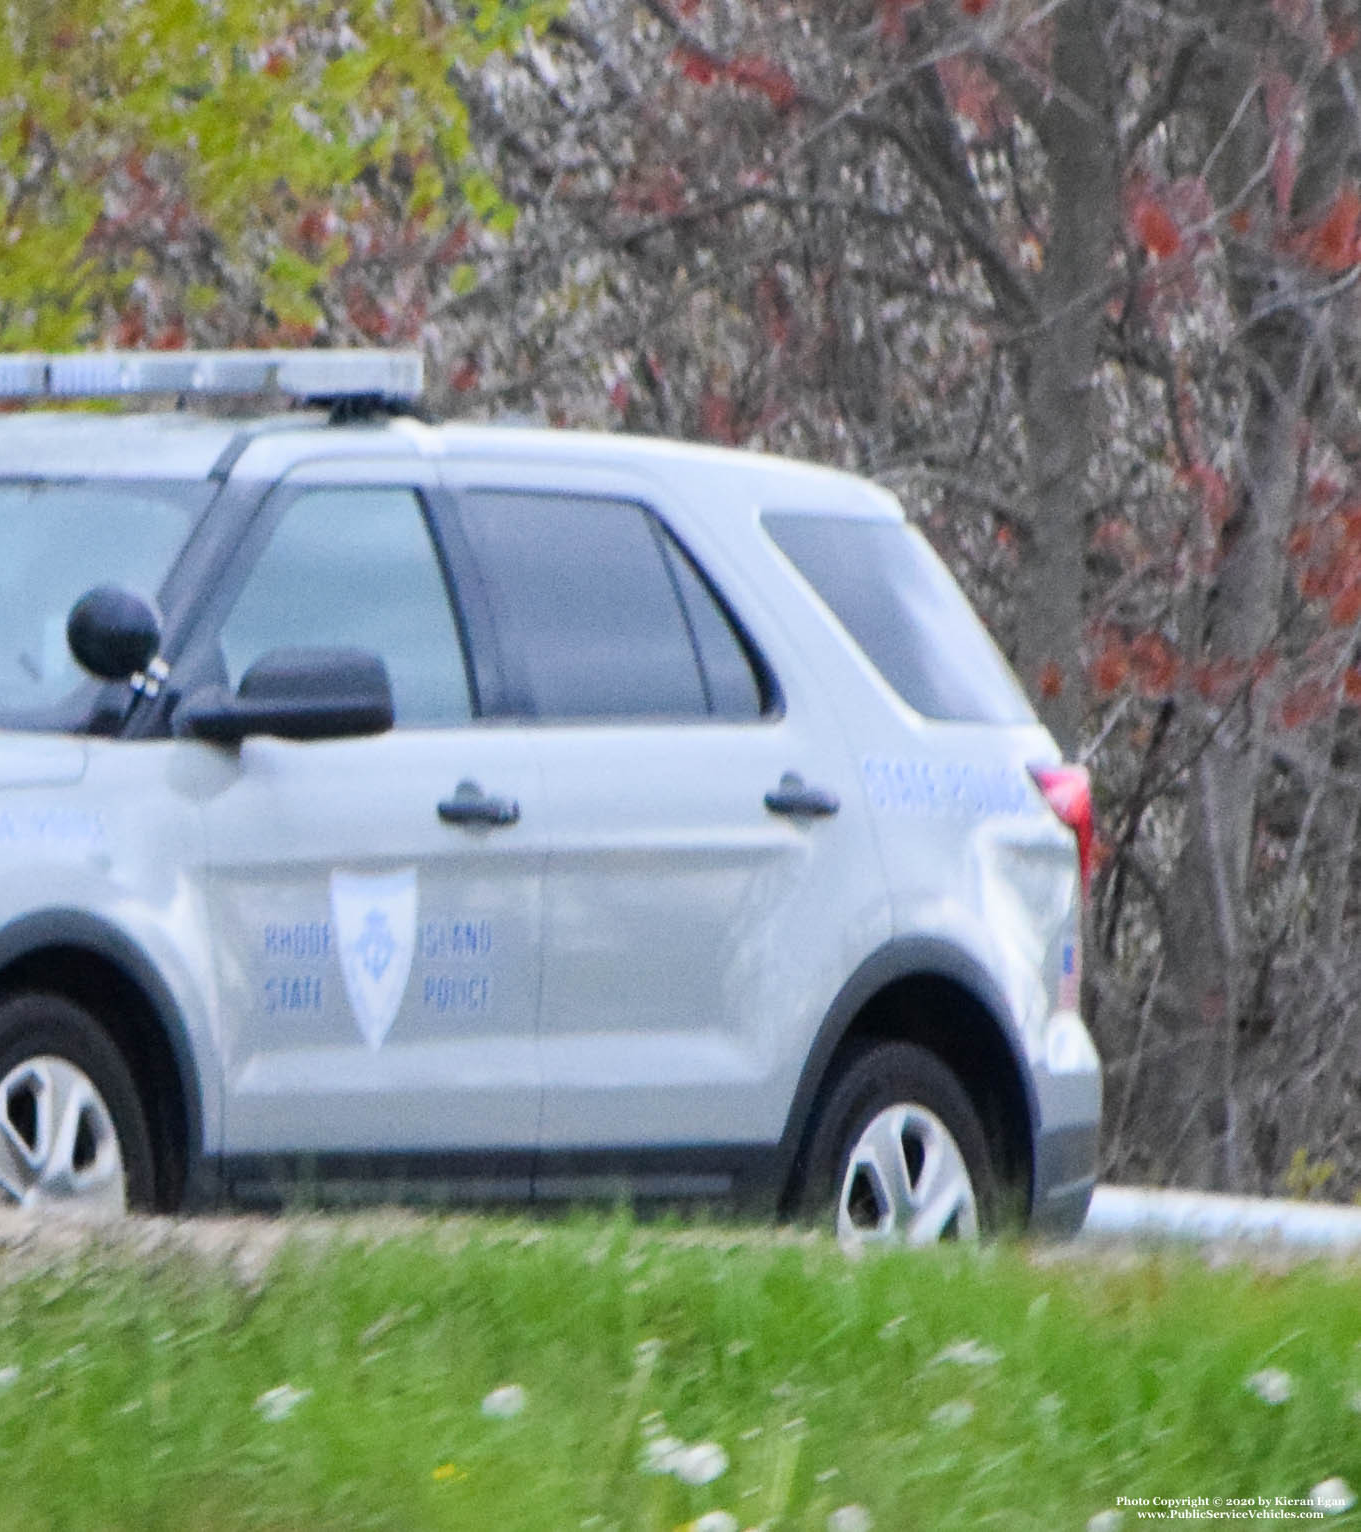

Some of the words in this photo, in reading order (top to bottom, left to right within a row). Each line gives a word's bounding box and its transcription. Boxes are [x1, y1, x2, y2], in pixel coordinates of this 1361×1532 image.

[264, 922, 331, 957] RHODE
[418, 920, 492, 957] ISLAND
[264, 976, 323, 1013] STATE
[423, 976, 489, 1013] POLICE
